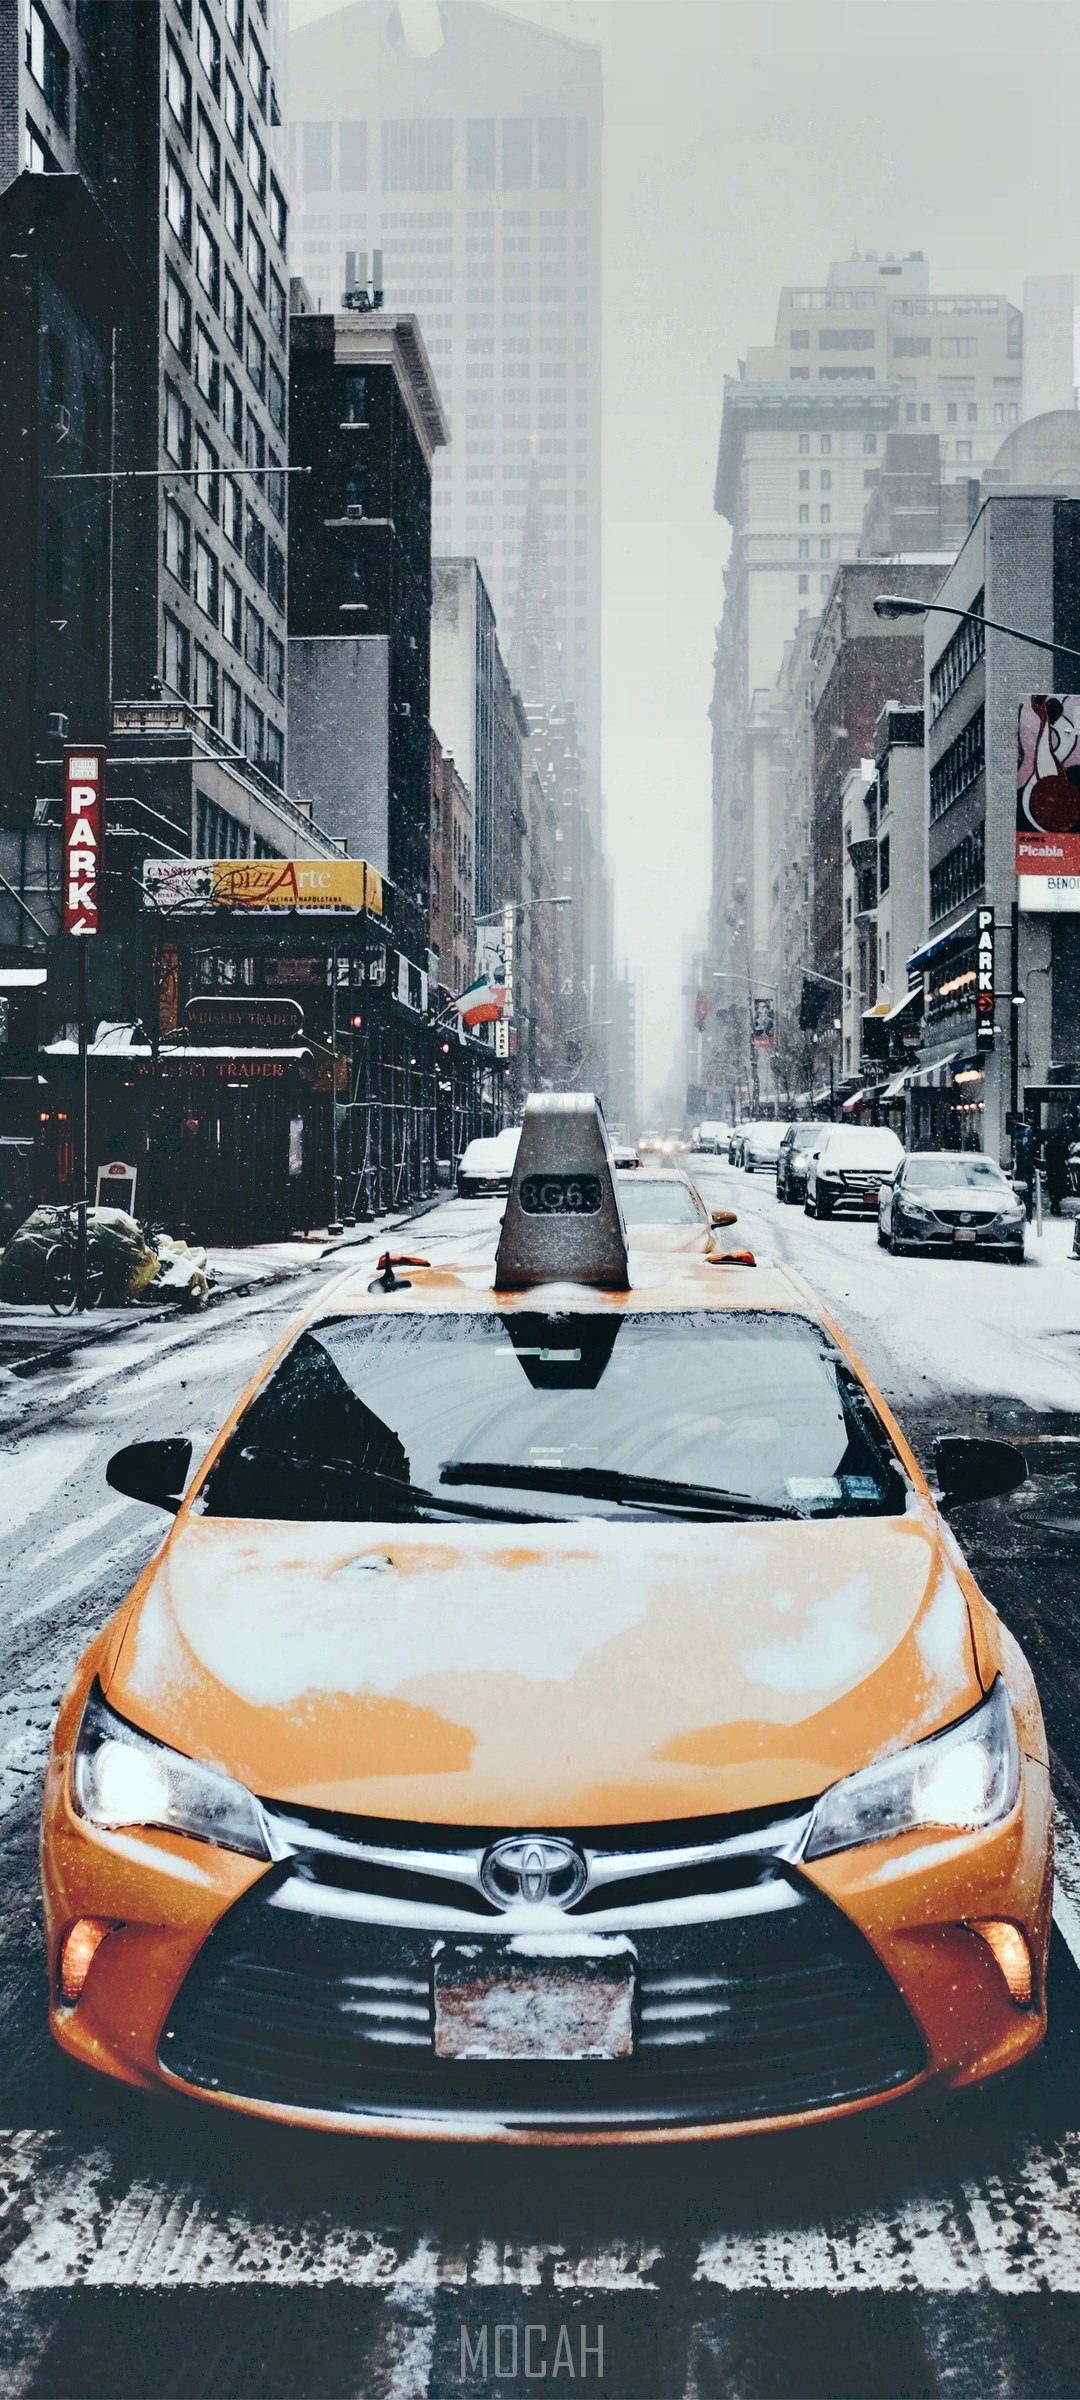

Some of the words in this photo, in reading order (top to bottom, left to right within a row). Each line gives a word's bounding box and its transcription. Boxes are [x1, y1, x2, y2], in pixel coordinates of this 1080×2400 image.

[68, 786, 98, 910] PARK
[1019, 844, 1064, 857] Picabia
[1047, 877, 1080, 890] BENOI
[978, 911, 993, 990] PARK
[187, 1012, 243, 1024] WHISKEY
[248, 1012, 298, 1026] TRADER
[137, 1064, 207, 1077] WIKEY
[216, 1062, 286, 1078] TRADER
[521, 1181, 603, 1208] 8G63
